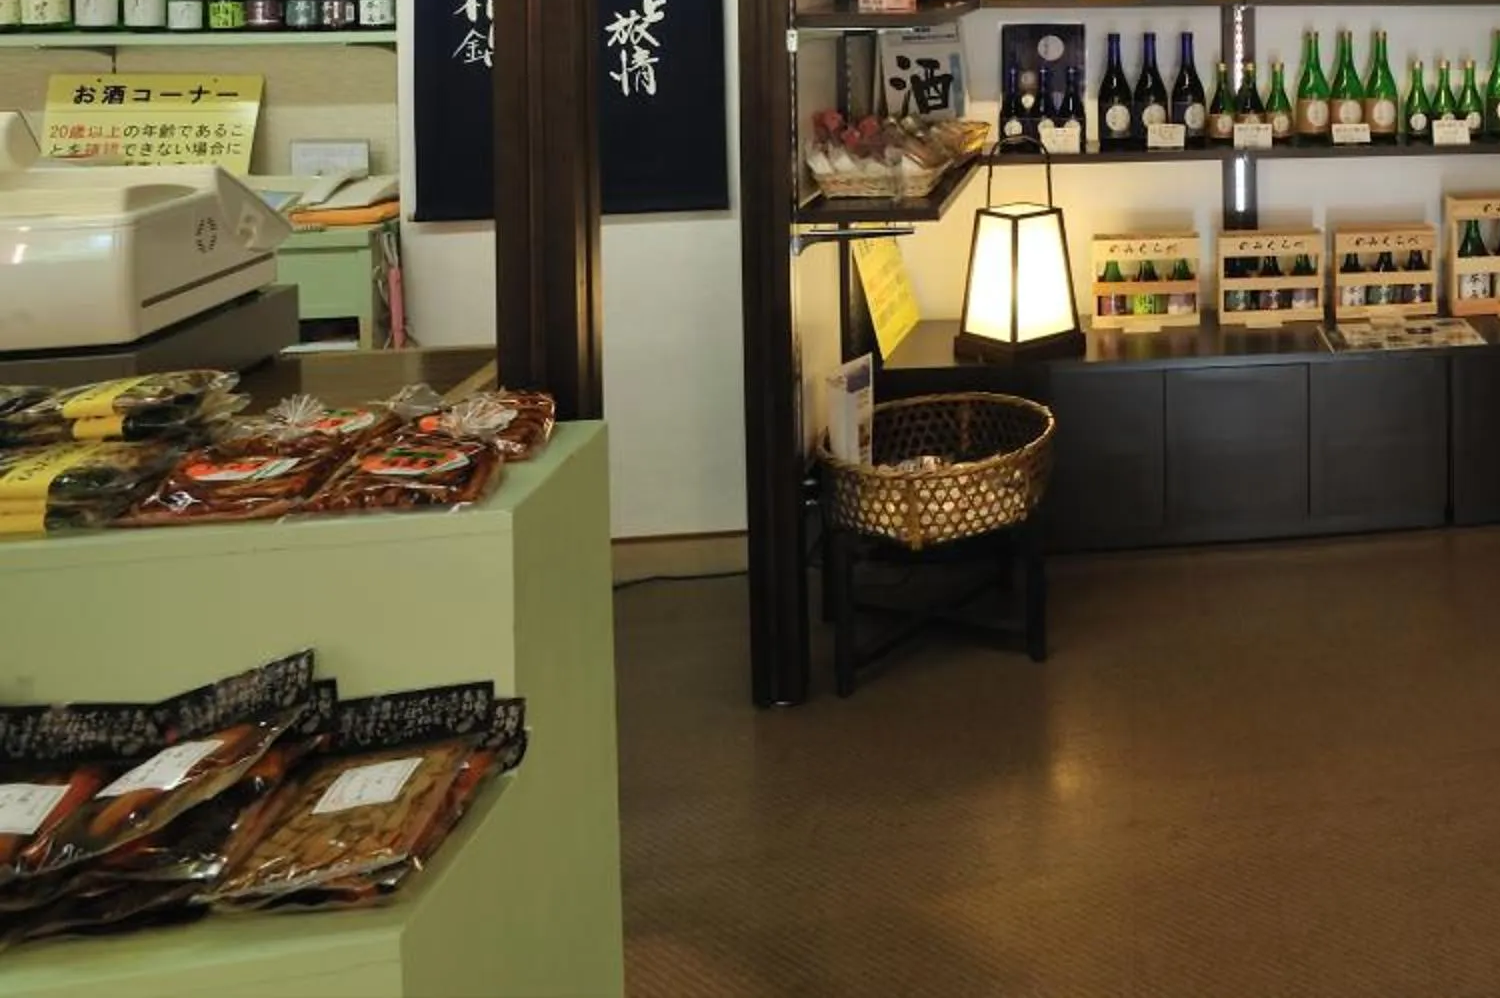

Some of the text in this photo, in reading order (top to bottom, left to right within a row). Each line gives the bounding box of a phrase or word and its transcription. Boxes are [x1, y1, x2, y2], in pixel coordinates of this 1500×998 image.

[73, 85, 239, 105] お酒コーナー
[889, 55, 954, 118] 酒
[49, 123, 244, 140] 20歳以上の年齢であるこ
